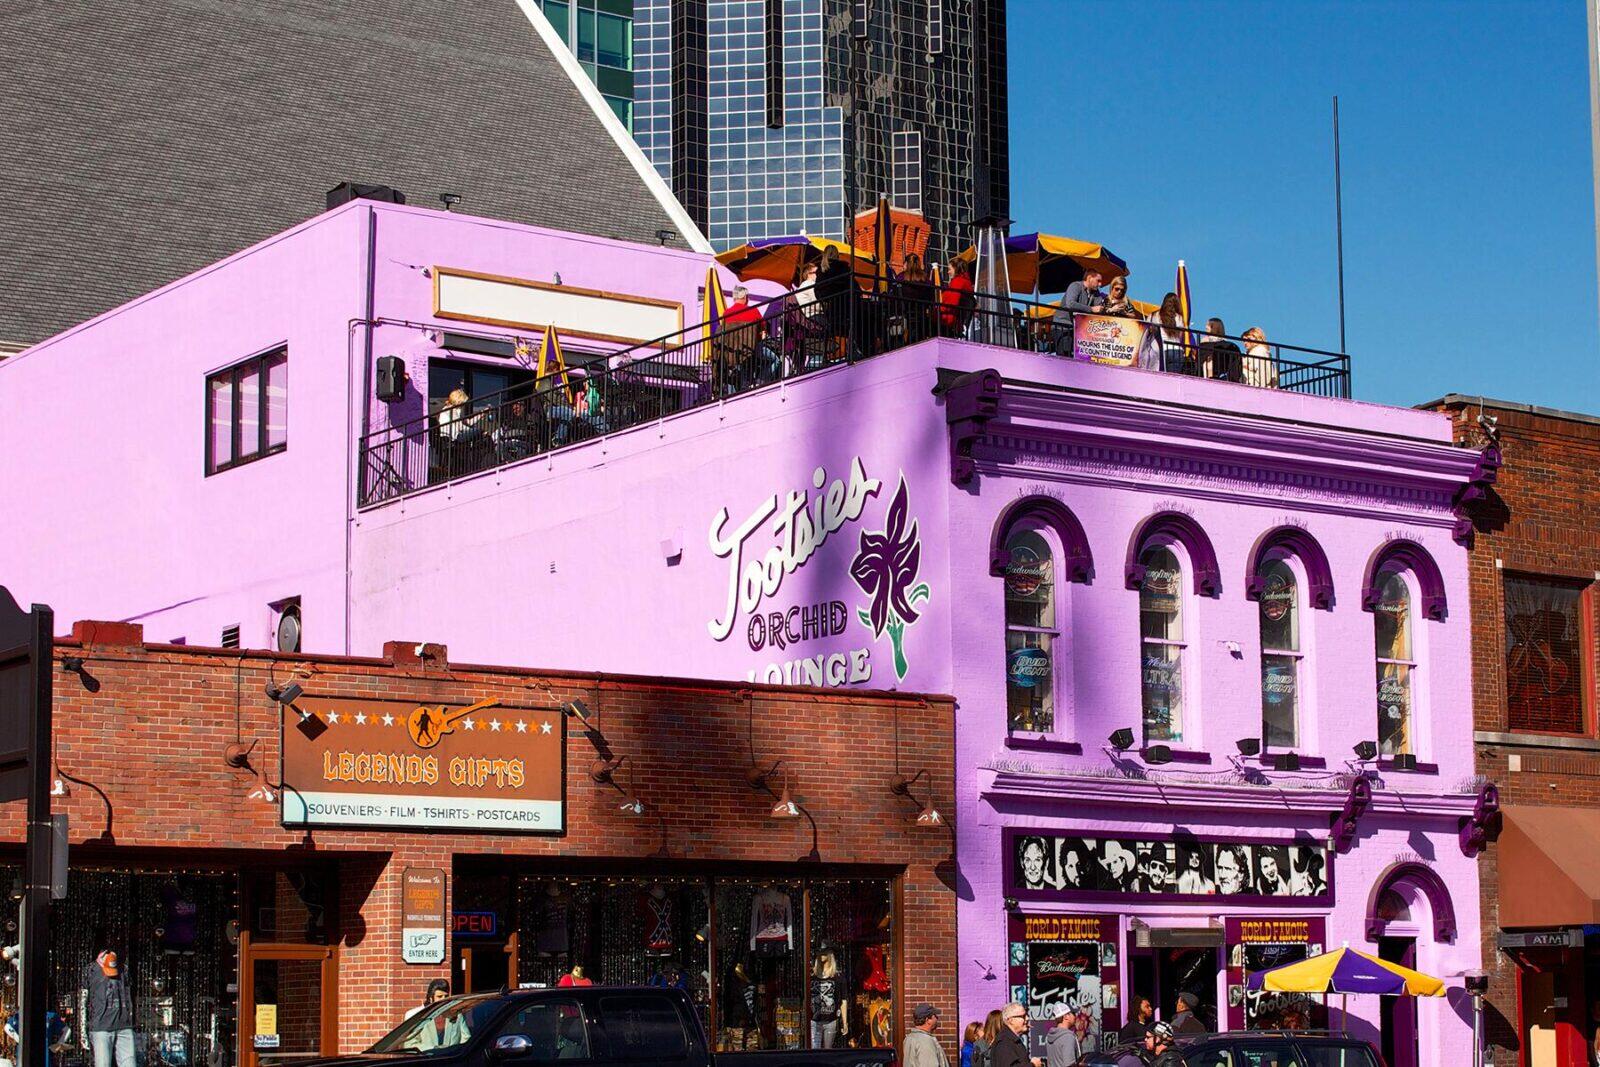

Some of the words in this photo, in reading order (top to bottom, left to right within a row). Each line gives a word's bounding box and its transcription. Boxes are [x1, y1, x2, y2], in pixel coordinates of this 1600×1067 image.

[1077, 340, 1101, 349] MOURNS
[1112, 345, 1126, 353] LOSS
[1085, 348, 1111, 357] COUNTRY
[1111, 352, 1132, 360] LEGEND
[707, 456, 882, 642] Tootsies
[747, 599, 848, 652] ORCHID
[1015, 656, 1048, 668] BUD
[1009, 665, 1051, 677] LIGHT
[322, 750, 439, 785] LEGENDS
[449, 756, 525, 789] GIFTS
[308, 803, 382, 816] SOUVENIERS
[390, 807, 416, 818] FILM
[423, 807, 470, 820] TSHIRTS
[476, 809, 541, 822] POSTCARDS
[1025, 918, 1059, 939] WORLD
[1061, 918, 1100, 939] FAMOUS
[1241, 921, 1271, 941] WORLD
[1273, 921, 1309, 941] FAMOUS
[1532, 935, 1561, 945] ATM
[1037, 960, 1086, 973] Budweiser
